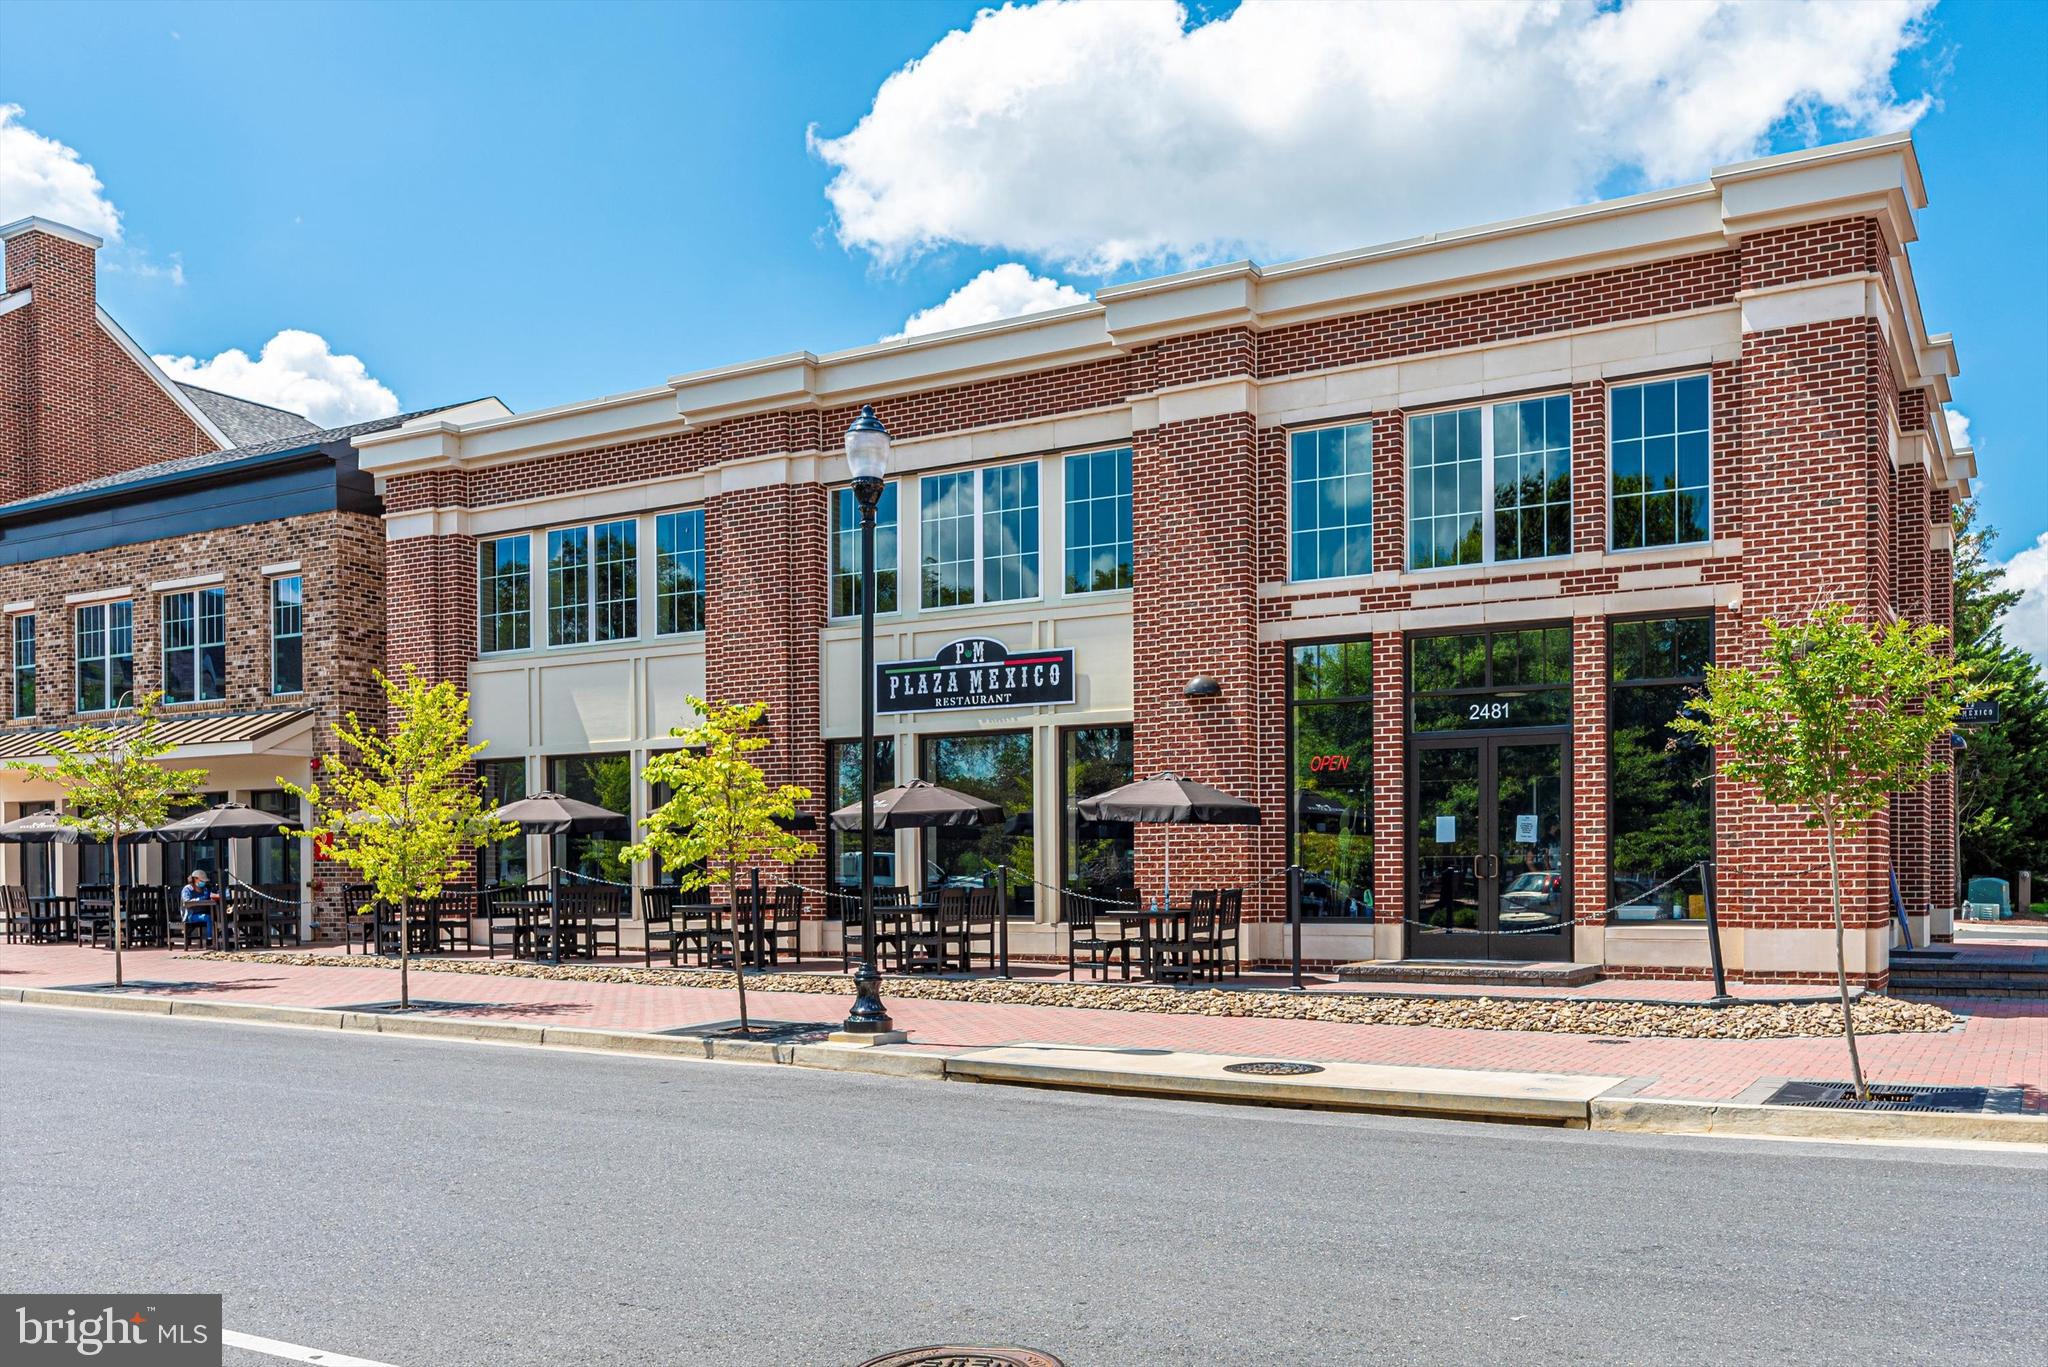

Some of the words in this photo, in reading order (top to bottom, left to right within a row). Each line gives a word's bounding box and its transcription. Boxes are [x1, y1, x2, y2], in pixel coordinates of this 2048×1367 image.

[889, 671, 959, 699] PLAZA
[969, 663, 1060, 694] MEXICO
[935, 693, 1012, 707] RESTAURANT
[1469, 702, 1509, 720] 2481
[1310, 755, 1350, 772] OPEN
